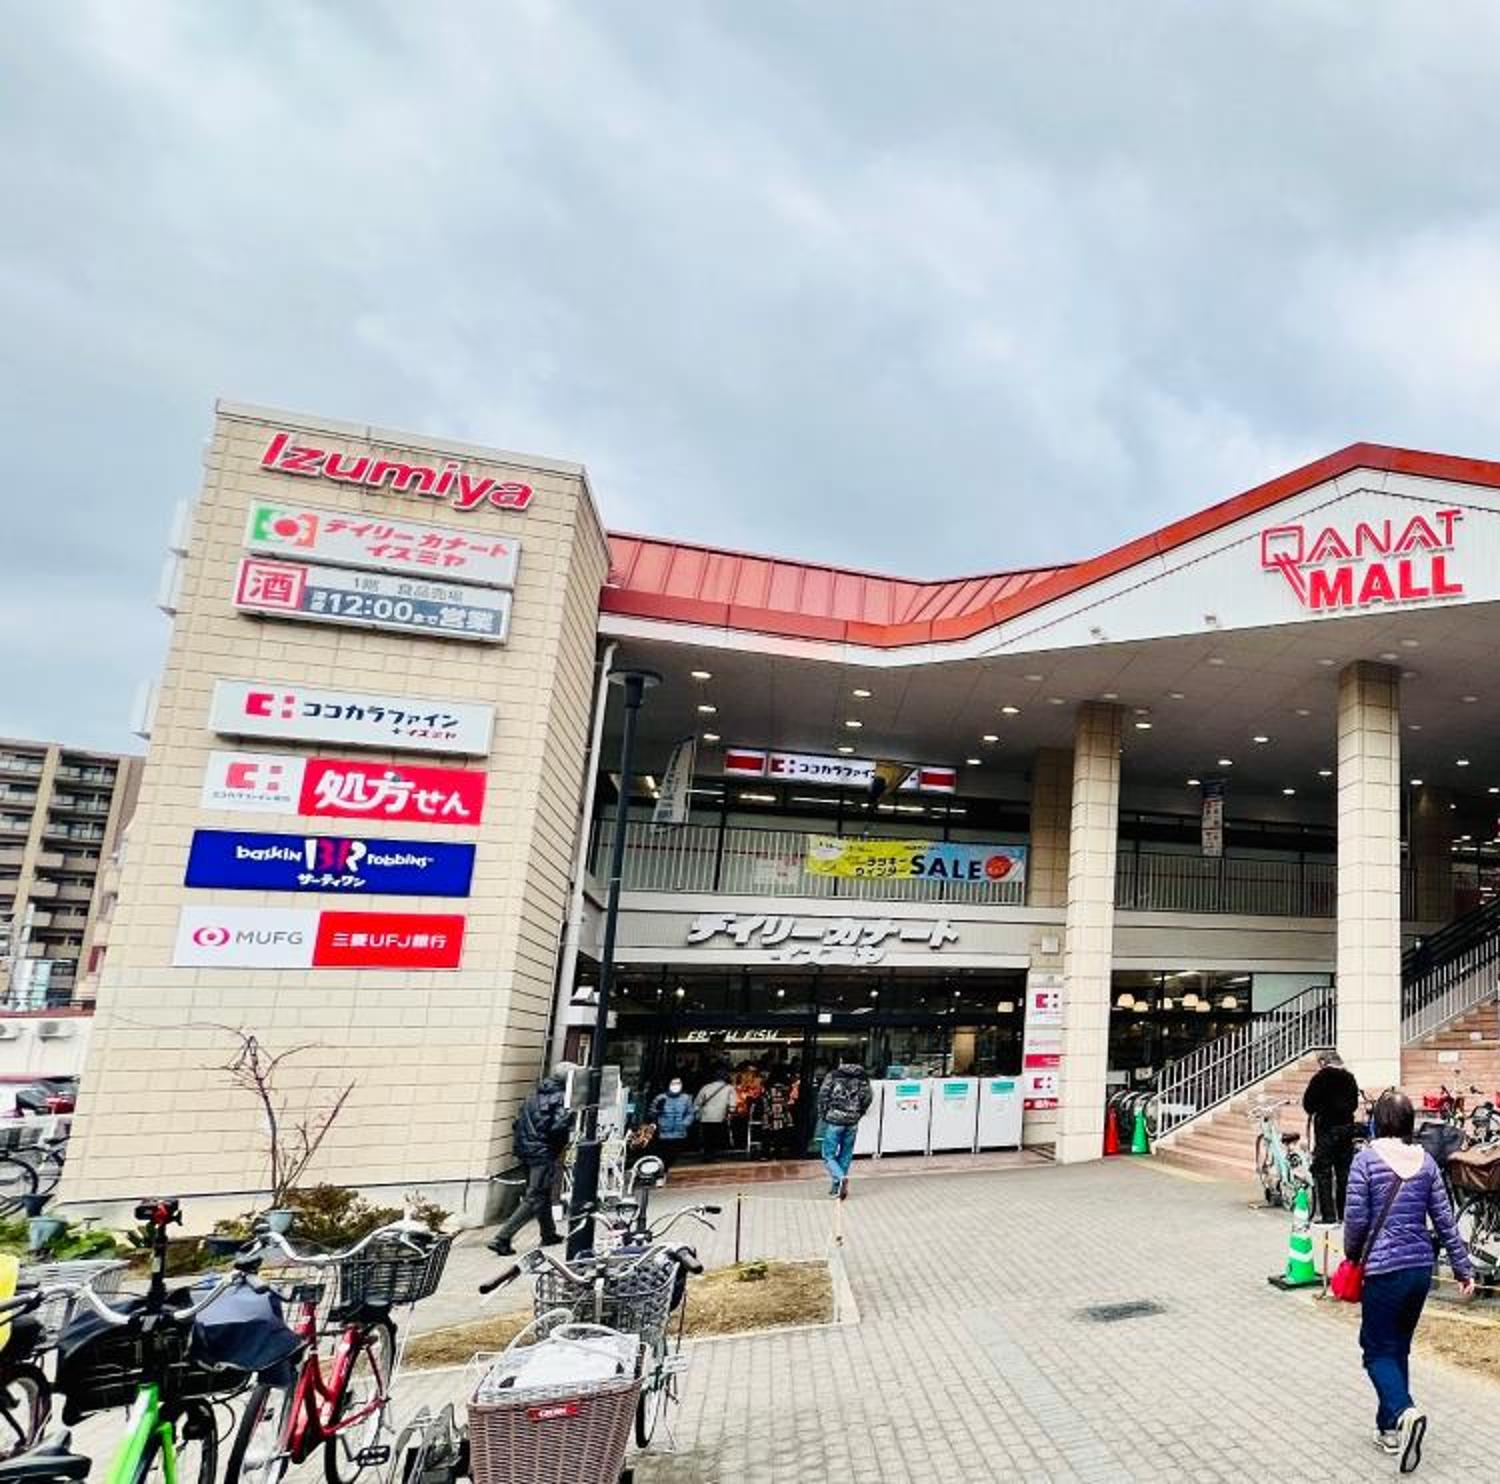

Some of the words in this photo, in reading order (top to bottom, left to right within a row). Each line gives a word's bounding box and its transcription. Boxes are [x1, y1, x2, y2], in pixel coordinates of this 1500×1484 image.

[261, 431, 534, 510] Izumiya
[1261, 509, 1463, 606] QANAT
[247, 569, 295, 603] 酒
[1308, 555, 1464, 609] MALL
[303, 702, 459, 729] ココカラファイン
[314, 769, 471, 817] 処方せん
[236, 845, 303, 862] baskin
[367, 852, 429, 869] robbins
[909, 854, 982, 880] SALE
[297, 873, 366, 888] サーティワン
[236, 930, 303, 945] MUFG
[332, 931, 448, 949] 三菱UFJ銀行
[687, 1029, 738, 1041] FRH
